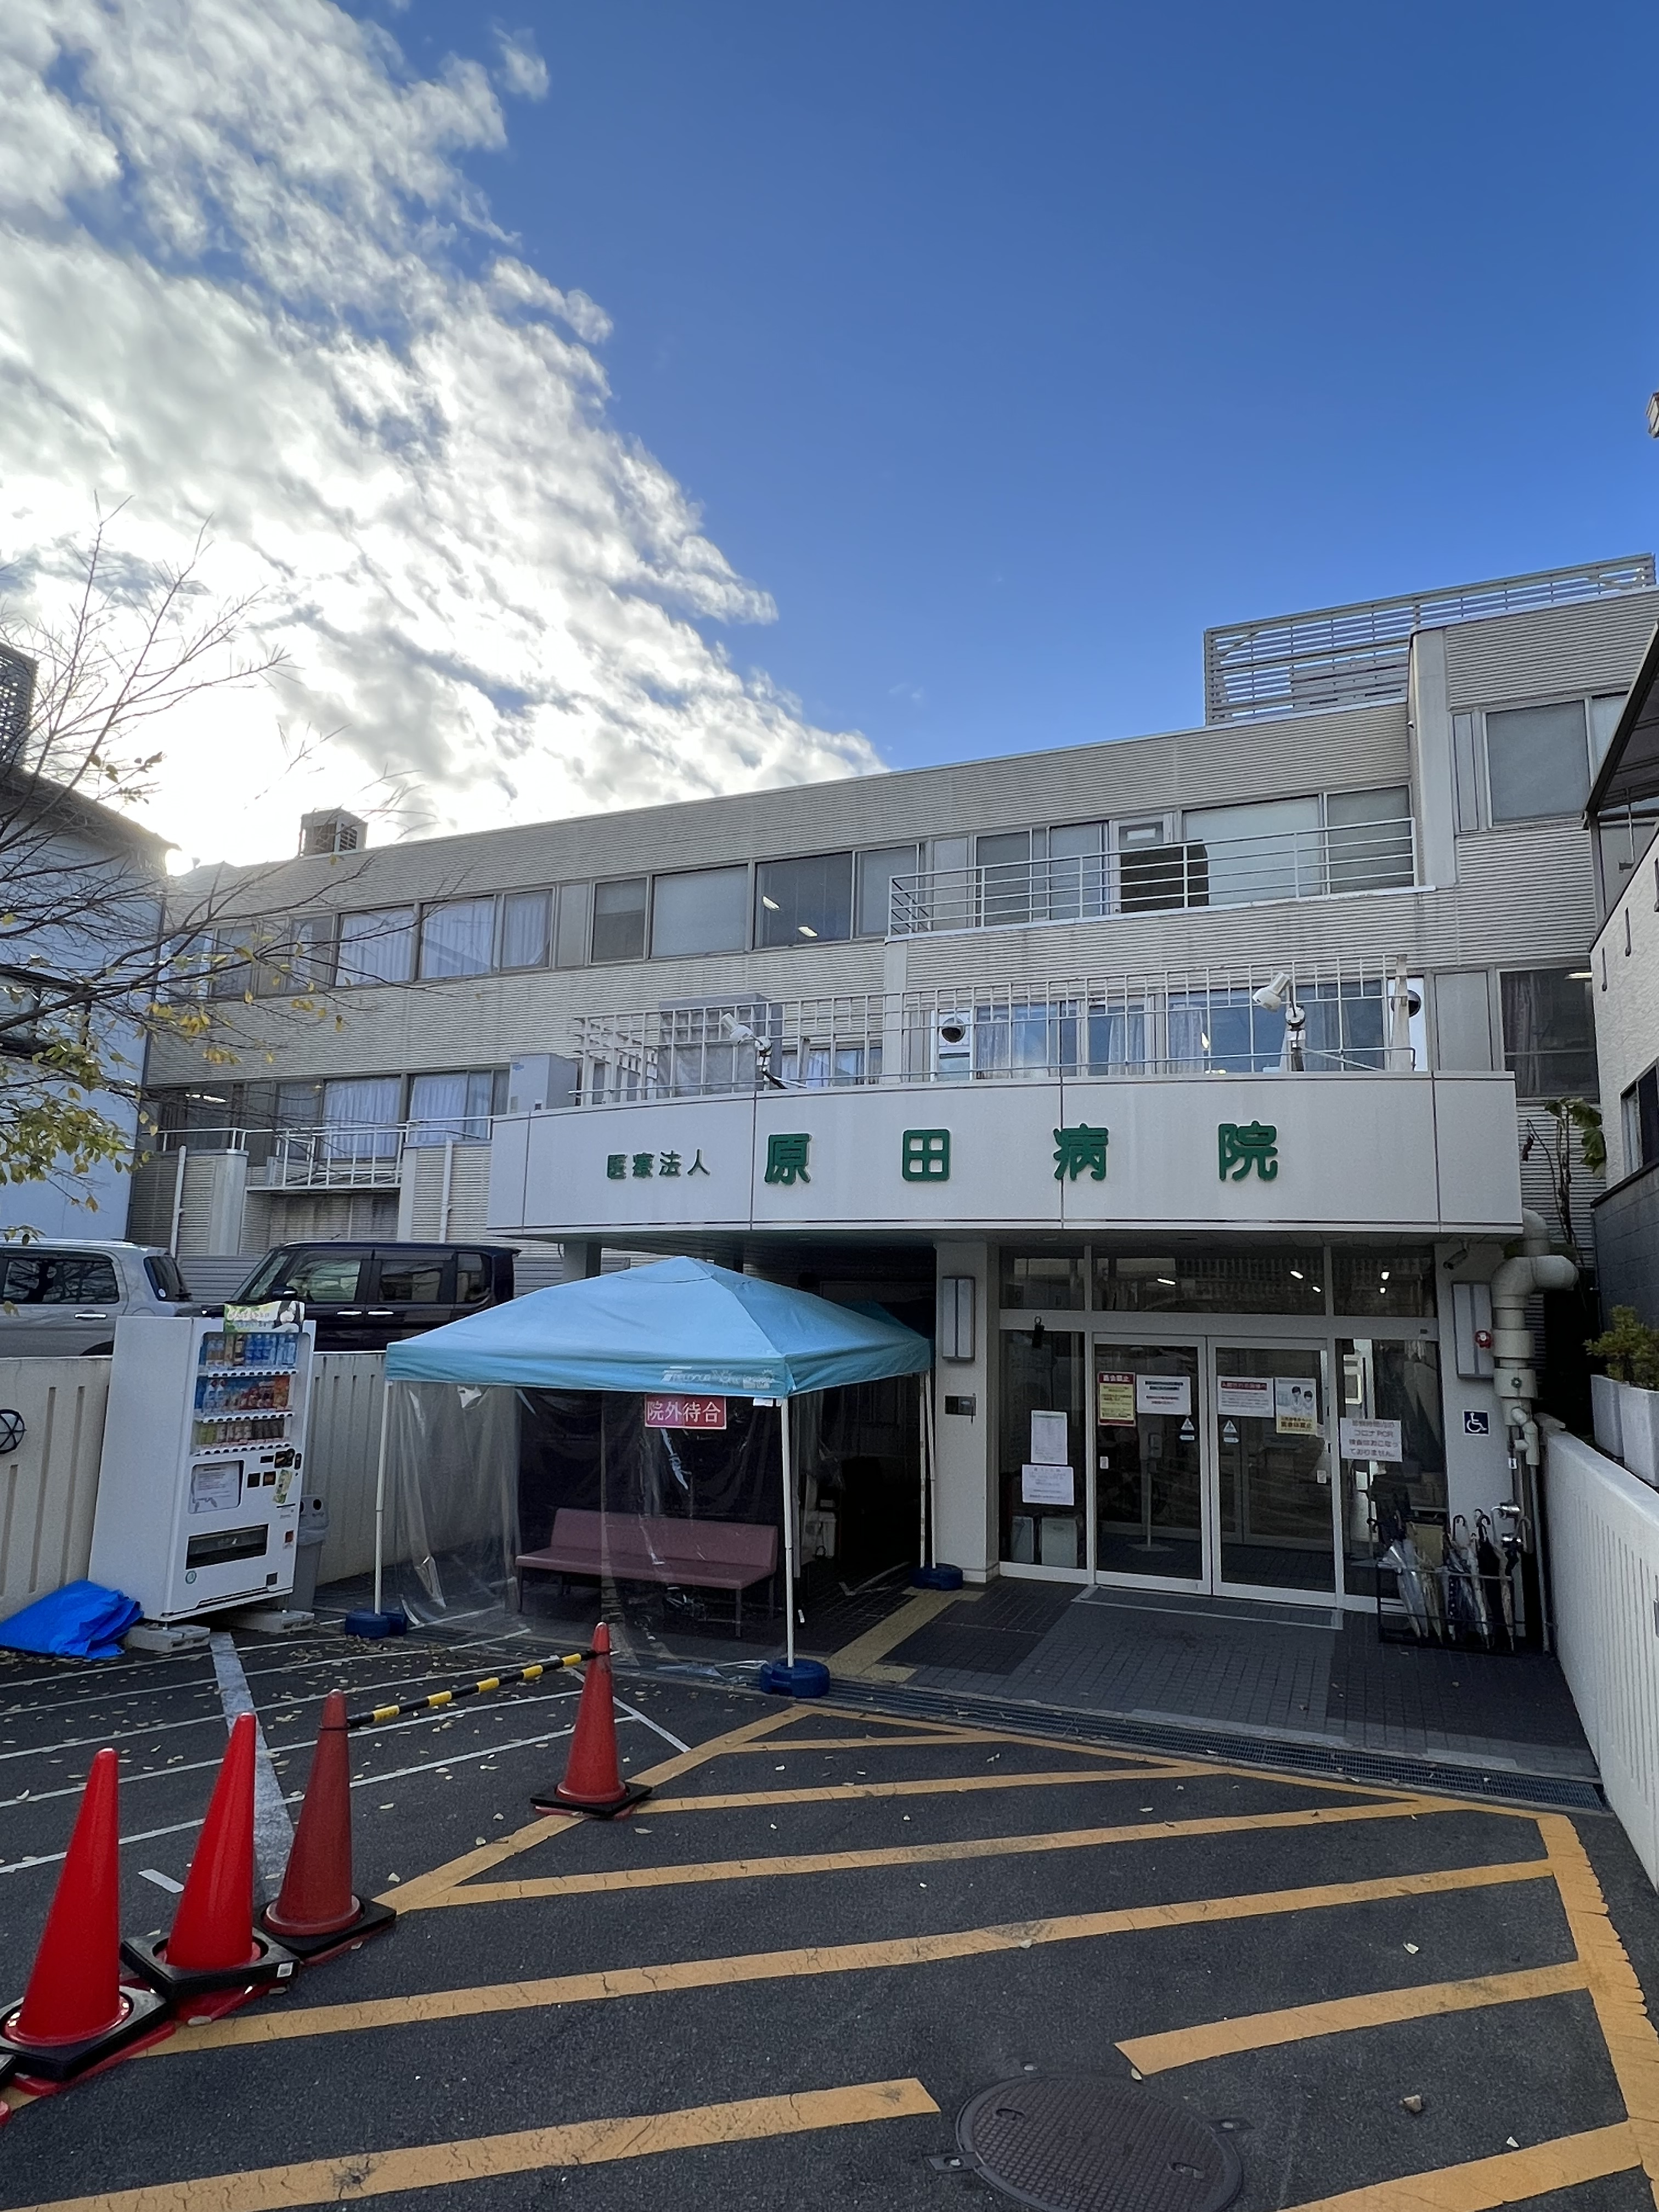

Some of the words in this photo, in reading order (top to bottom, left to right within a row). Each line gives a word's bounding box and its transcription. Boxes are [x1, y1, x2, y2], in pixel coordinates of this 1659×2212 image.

[607, 1149, 711, 1180] 医療法人
[764, 1120, 1278, 1185] 原田病院
[647, 1401, 721, 1423] 院外待合
